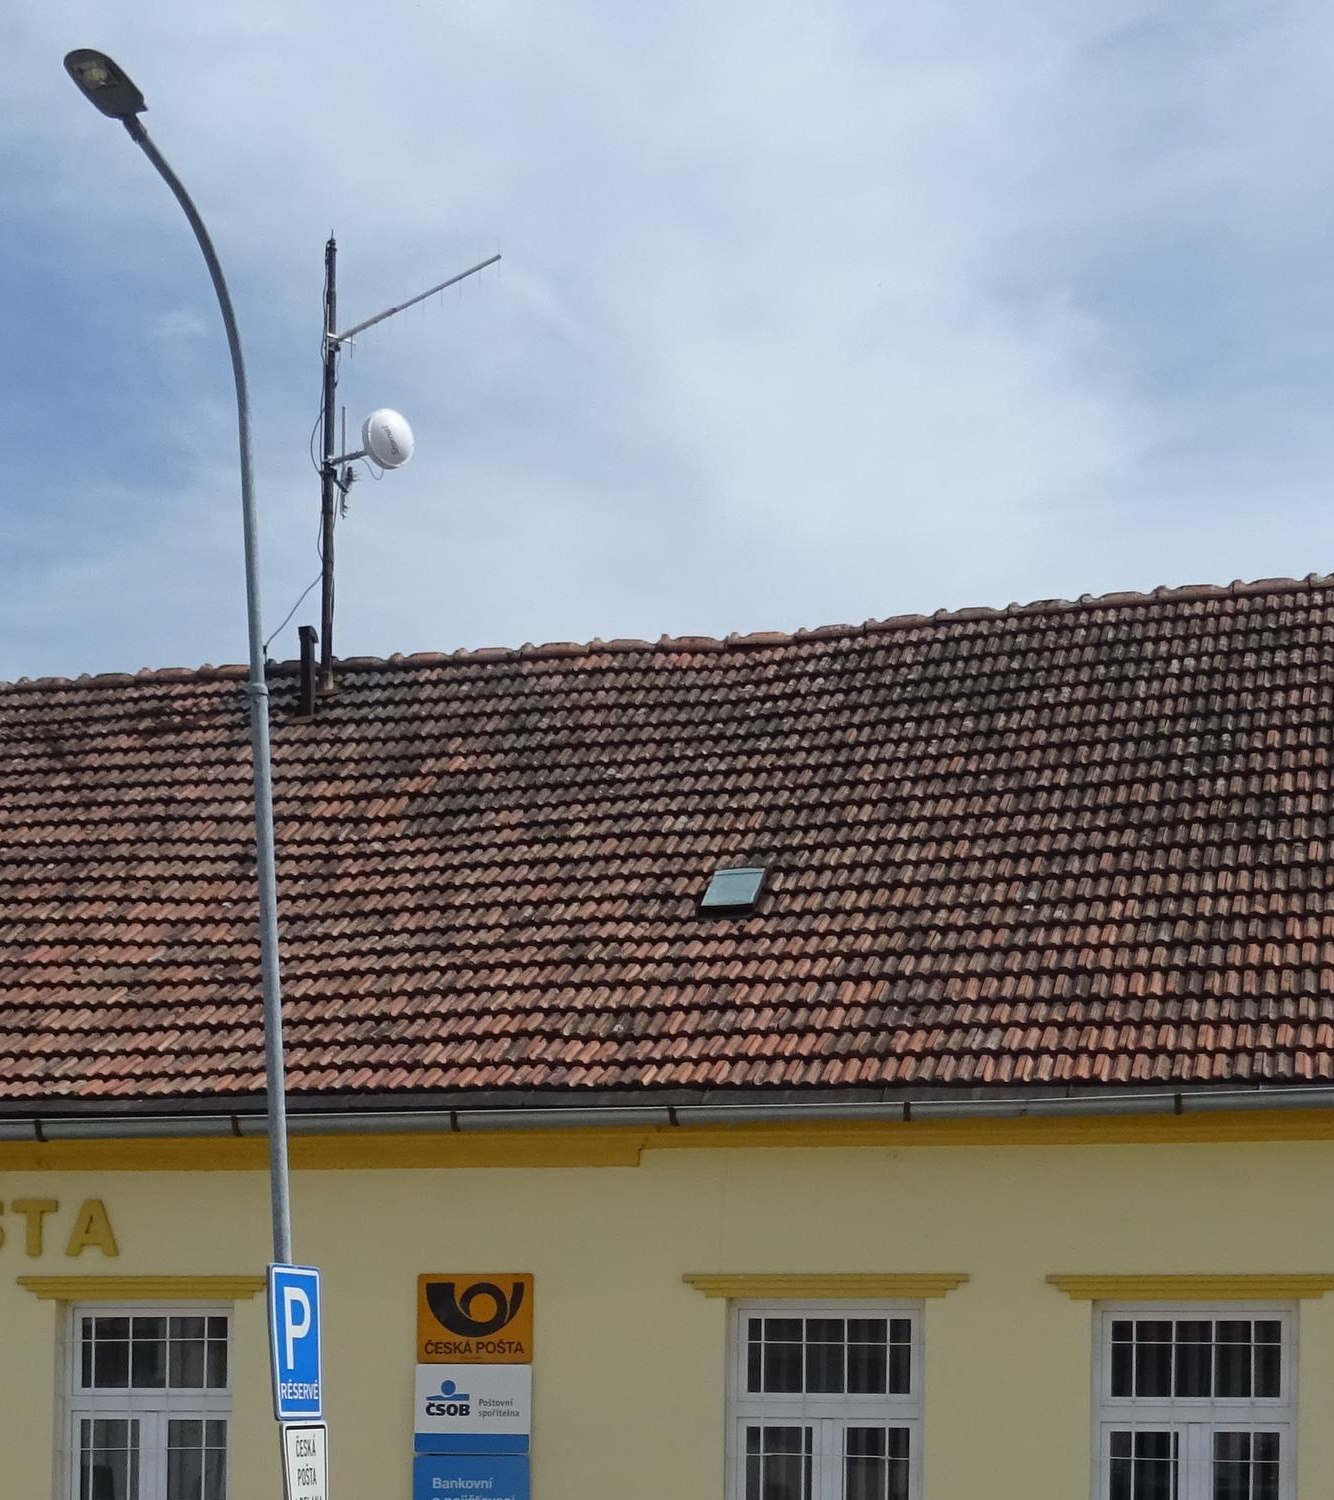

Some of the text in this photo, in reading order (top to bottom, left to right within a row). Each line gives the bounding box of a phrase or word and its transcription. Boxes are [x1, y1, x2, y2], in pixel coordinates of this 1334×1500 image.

[283, 1286, 311, 1370] P
[424, 1339, 524, 1354] ČESKÁ POŠTA
[280, 1379, 319, 1400] RÉSERVÉ
[426, 1402, 470, 1416] ČSOB
[478, 1398, 514, 1407] Poštovní
[478, 1408, 520, 1418] spořitelna
[295, 1434, 317, 1458] ČESKÁ
[297, 1463, 317, 1486] POŠTA
[432, 1477, 493, 1489] Bankovní
